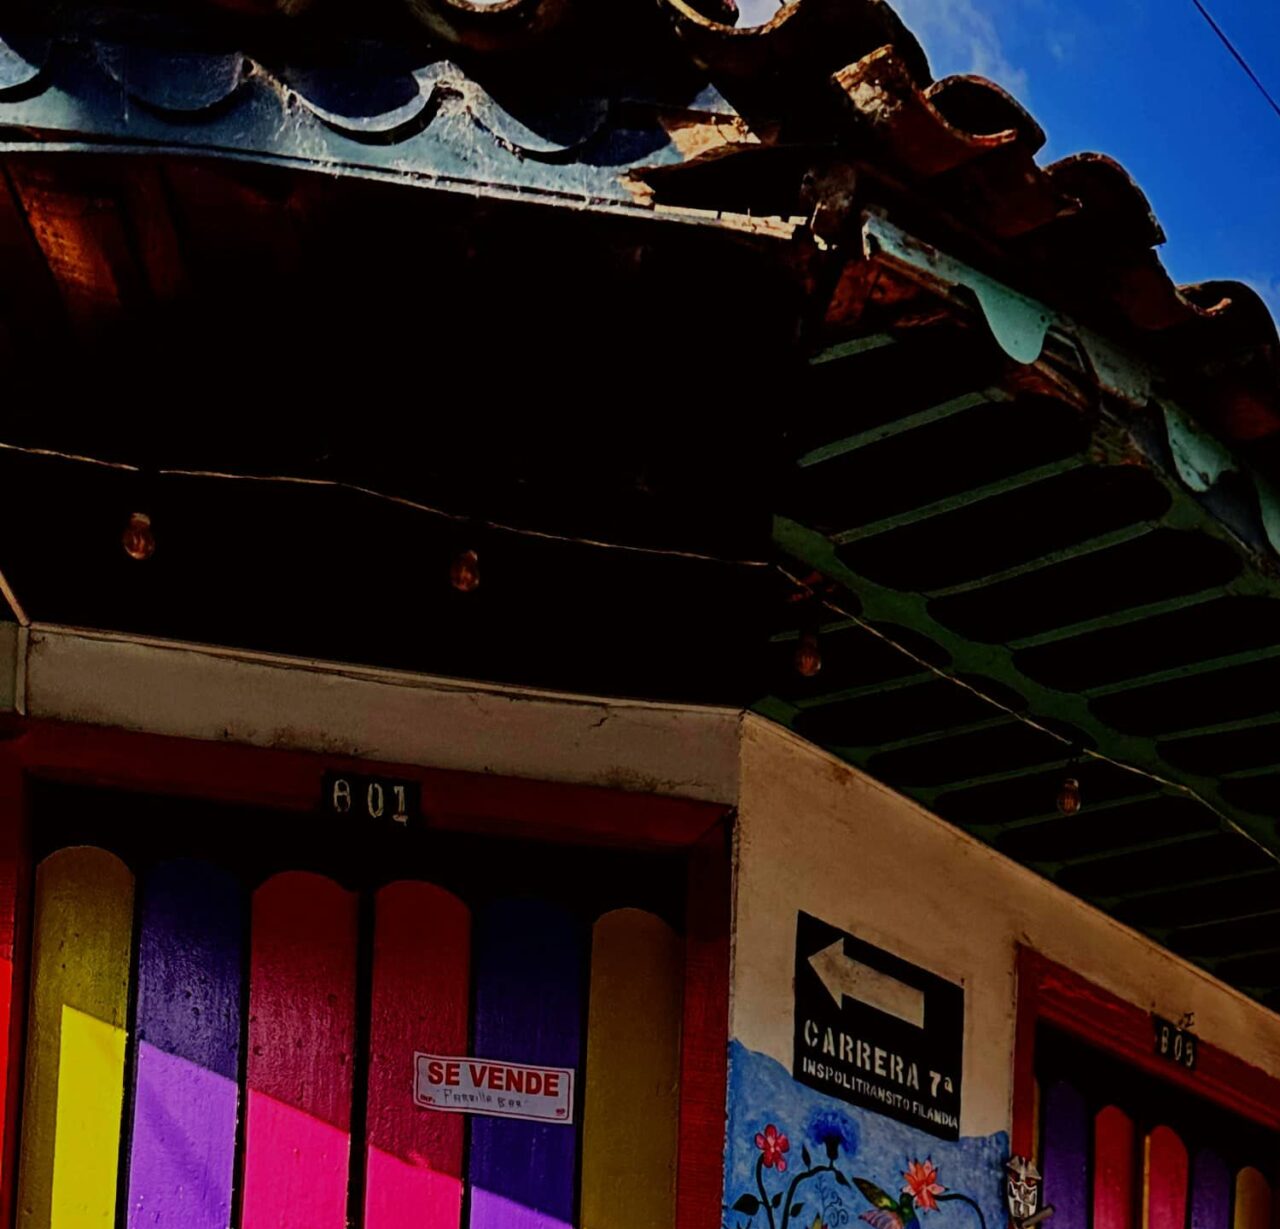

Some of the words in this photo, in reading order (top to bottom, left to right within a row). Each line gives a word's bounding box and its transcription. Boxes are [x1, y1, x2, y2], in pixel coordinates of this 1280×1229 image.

[427, 1061, 460, 1086] SE
[469, 1064, 560, 1097] VENDE
[804, 1019, 919, 1090] CARRERA
